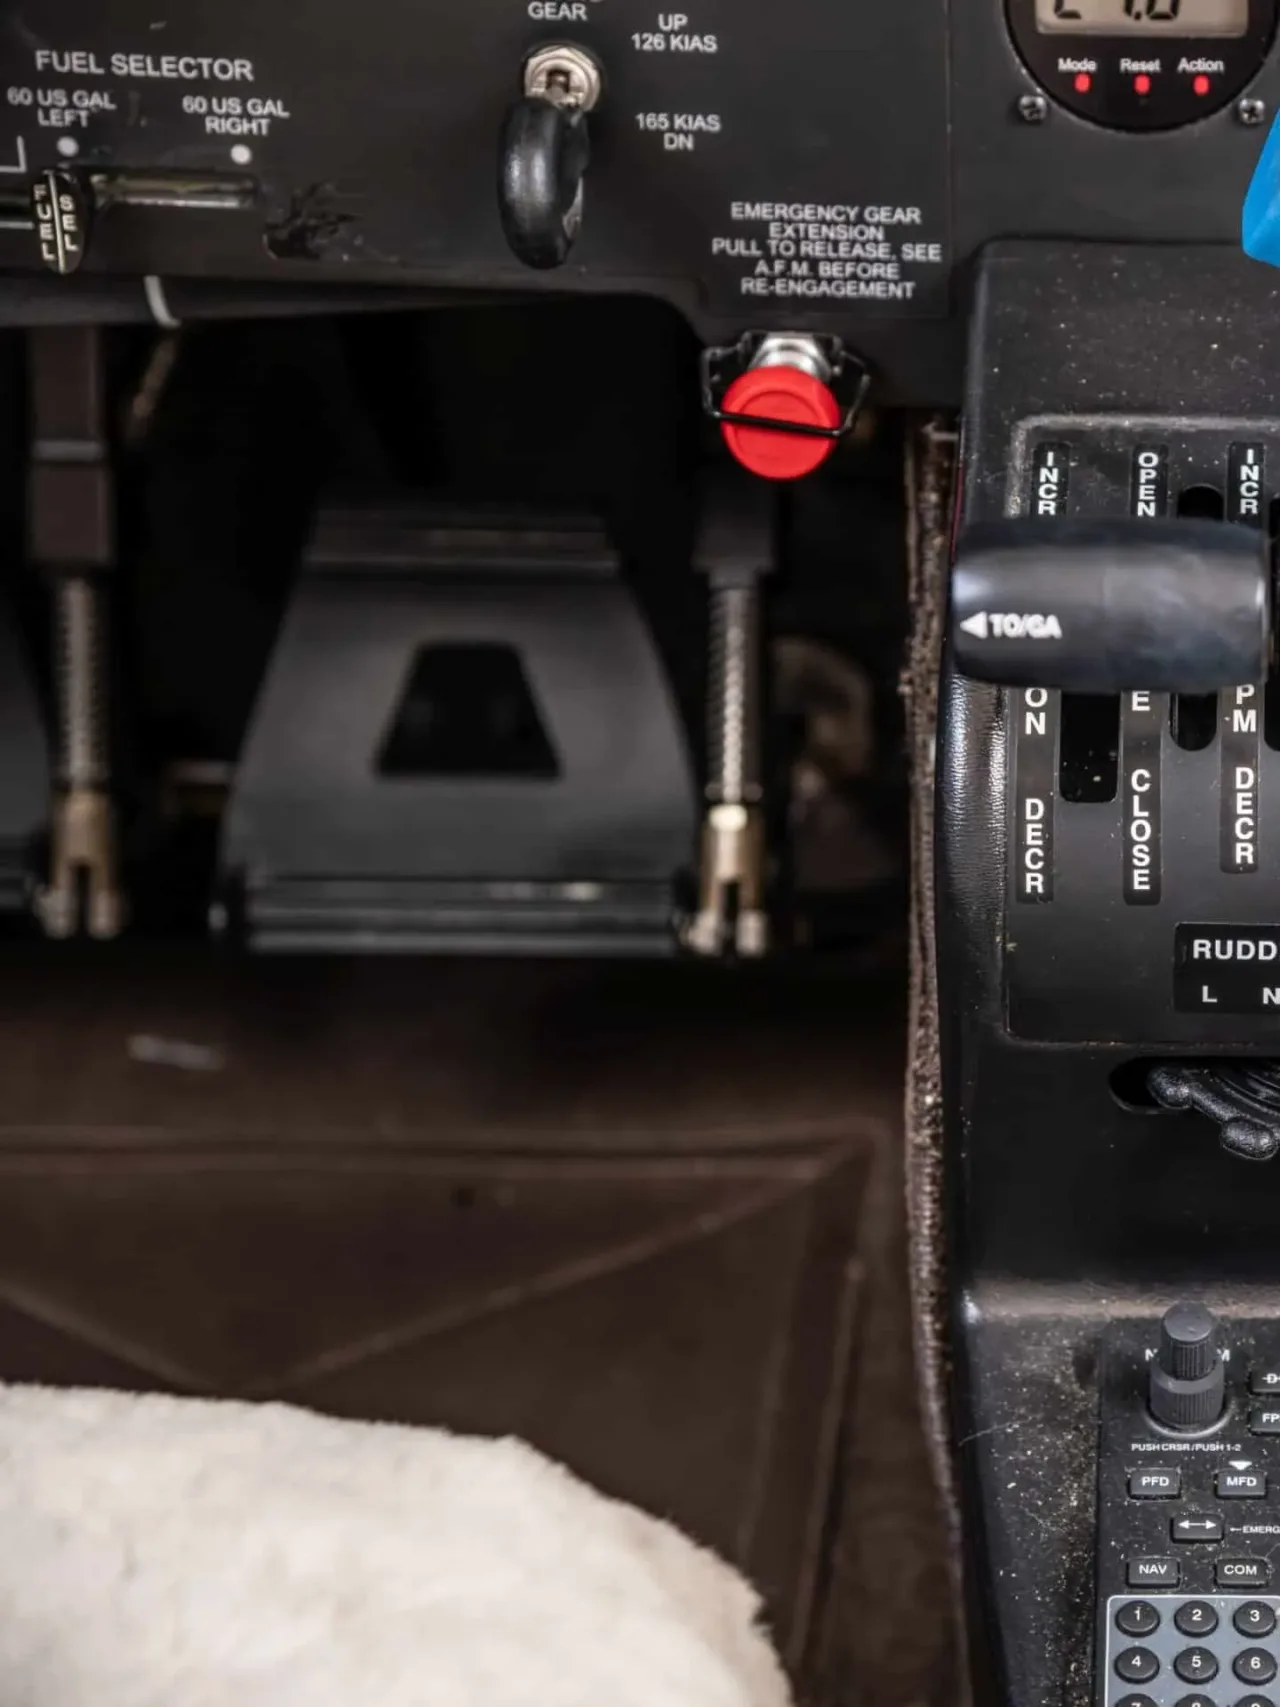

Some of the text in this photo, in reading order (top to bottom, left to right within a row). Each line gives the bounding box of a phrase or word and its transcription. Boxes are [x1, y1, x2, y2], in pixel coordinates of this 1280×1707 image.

[528, 2, 586, 20] GEAR
[659, 14, 687, 31] UP
[632, 33, 717, 52] 126 KIAS
[36, 50, 253, 81] FUEL SELECTOR
[1059, 58, 1096, 71] Mode
[1121, 59, 1160, 71] Reset
[1178, 58, 1223, 71] Action
[8, 88, 116, 111] 60 US GAL
[183, 96, 289, 117] 60 US GAL
[38, 109, 88, 127] LEFT
[206, 117, 269, 135] RIGHT
[637, 113, 720, 131] 165 KIAS
[664, 133, 693, 149] DN
[33, 184, 79, 262] FUEL SEL
[732, 202, 920, 226] EMERGENCY GEAR
[769, 222, 883, 241] EXTENSION
[712, 238, 762, 256] PULL
[768, 239, 795, 256] TO
[902, 244, 940, 261] SEE
[819, 262, 898, 279] BEFORE
[742, 279, 915, 298] RE-ENGAGEMENT
[1038, 452, 1058, 515] INCR
[1138, 452, 1158, 516] OPEN
[1240, 449, 1259, 513] INCR
[1235, 767, 1254, 863] DECR
[1131, 769, 1151, 889] CLOSE
[1025, 798, 1044, 893] DECR
[1203, 986, 1217, 1002] L
[1142, 1477, 1169, 1486] PFD
[1227, 1477, 1256, 1486] MFD
[1139, 1565, 1167, 1574] NAV
[1224, 1565, 1257, 1575] COM
[1135, 1608, 1140, 1620] 1
[1192, 1609, 1201, 1620] 2
[1251, 1610, 1259, 1622] 3
[1132, 1656, 1141, 1666] 4
[1192, 1656, 1201, 1667] 5
[1251, 1657, 1260, 1669] 6
